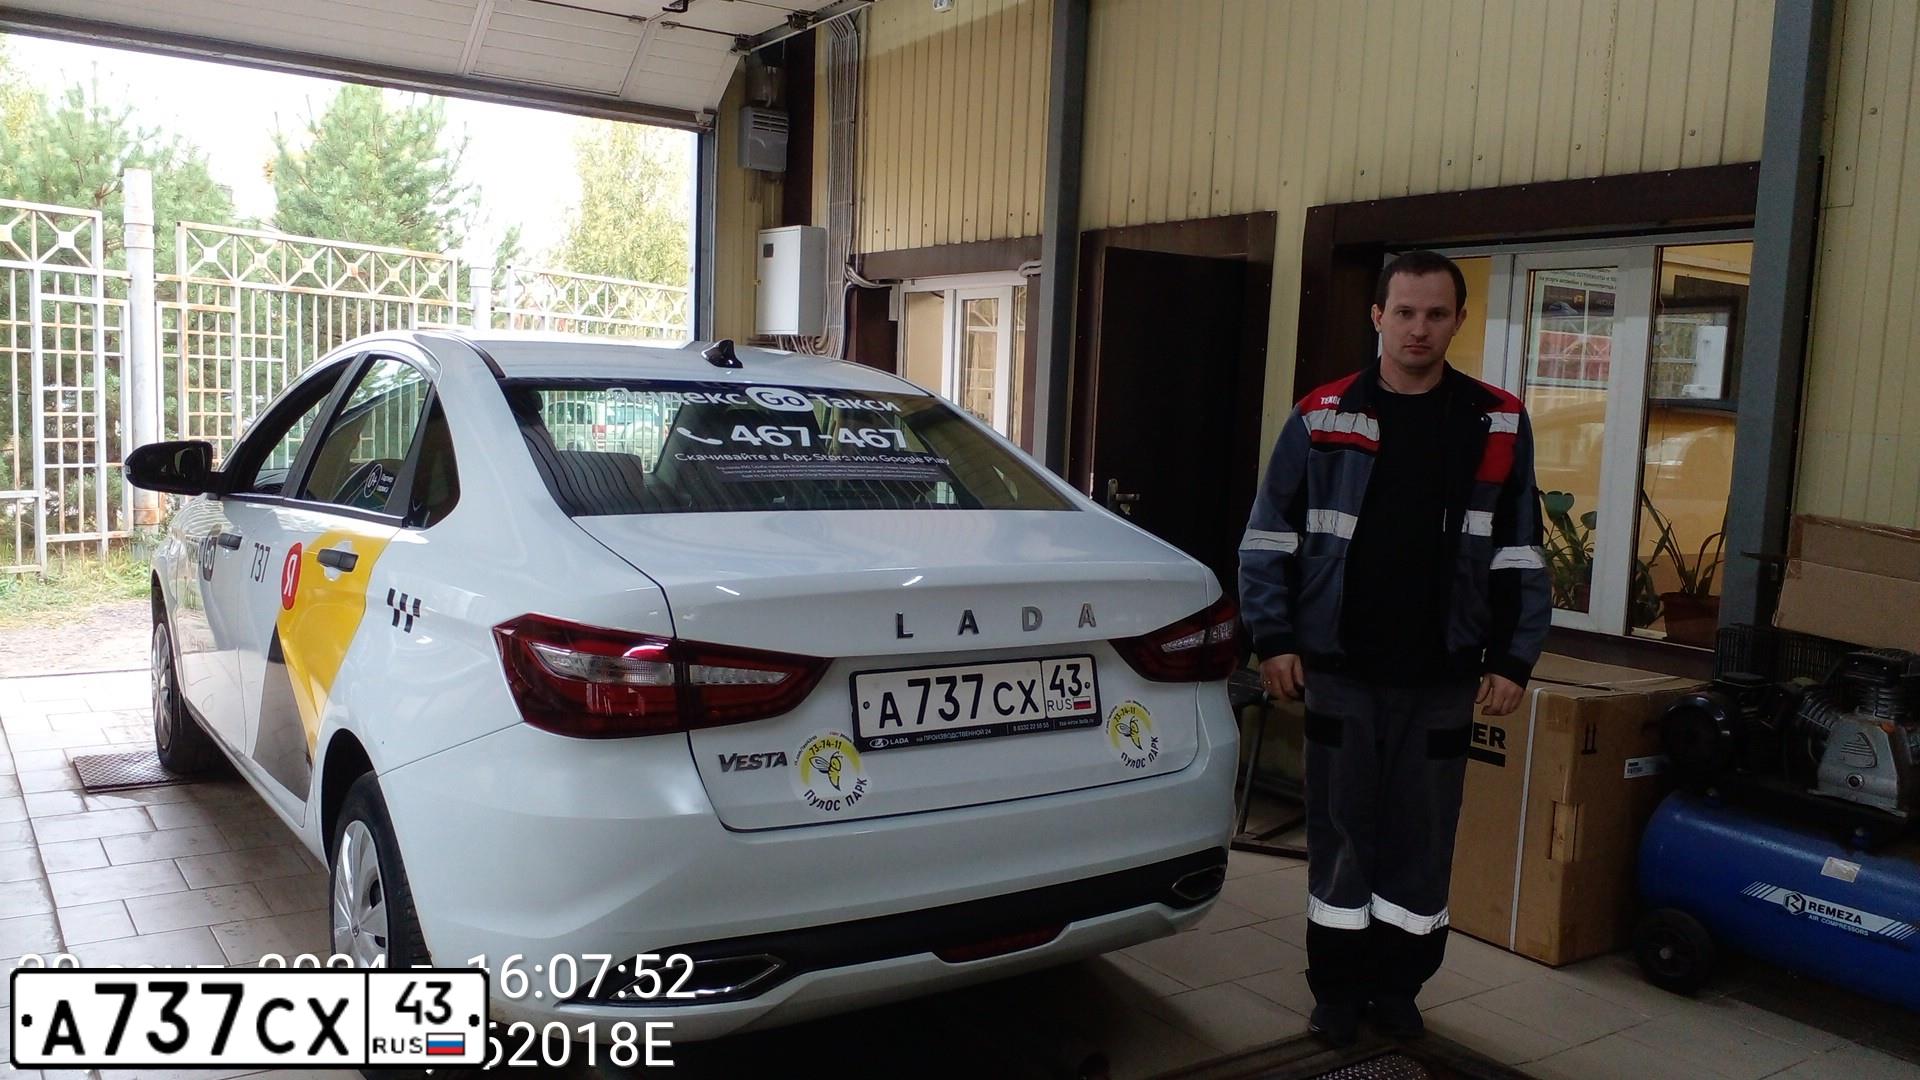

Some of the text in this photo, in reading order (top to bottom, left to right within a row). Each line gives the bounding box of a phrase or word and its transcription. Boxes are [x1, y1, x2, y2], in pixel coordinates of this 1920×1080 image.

[756, 391, 805, 406] Go
[808, 393, 902, 412] Такси
[731, 425, 907, 449] 467-467
[674, 451, 768, 462] Скачивайте
[783, 453, 811, 463] App
[812, 453, 851, 463] Store
[852, 455, 877, 463] или
[879, 454, 924, 465] Google
[924, 456, 950, 466] Play
[250, 542, 271, 583] 737
[284, 554, 298, 597] Я
[895, 603, 1097, 639] LADA
[1050, 664, 1083, 698] 43
[1048, 699, 1073, 712] RUS
[808, 739, 842, 756] 73-74-11
[889, 737, 909, 745] LADA
[1473, 722, 1506, 750] ER
[718, 751, 788, 772] VESTA
[1148, 736, 1159, 763] ПАРК
[845, 778, 868, 807] ПАРК
[1808, 901, 1863, 926] REMEZA
[1808, 914, 1869, 937] AIR COMPRESSORS
